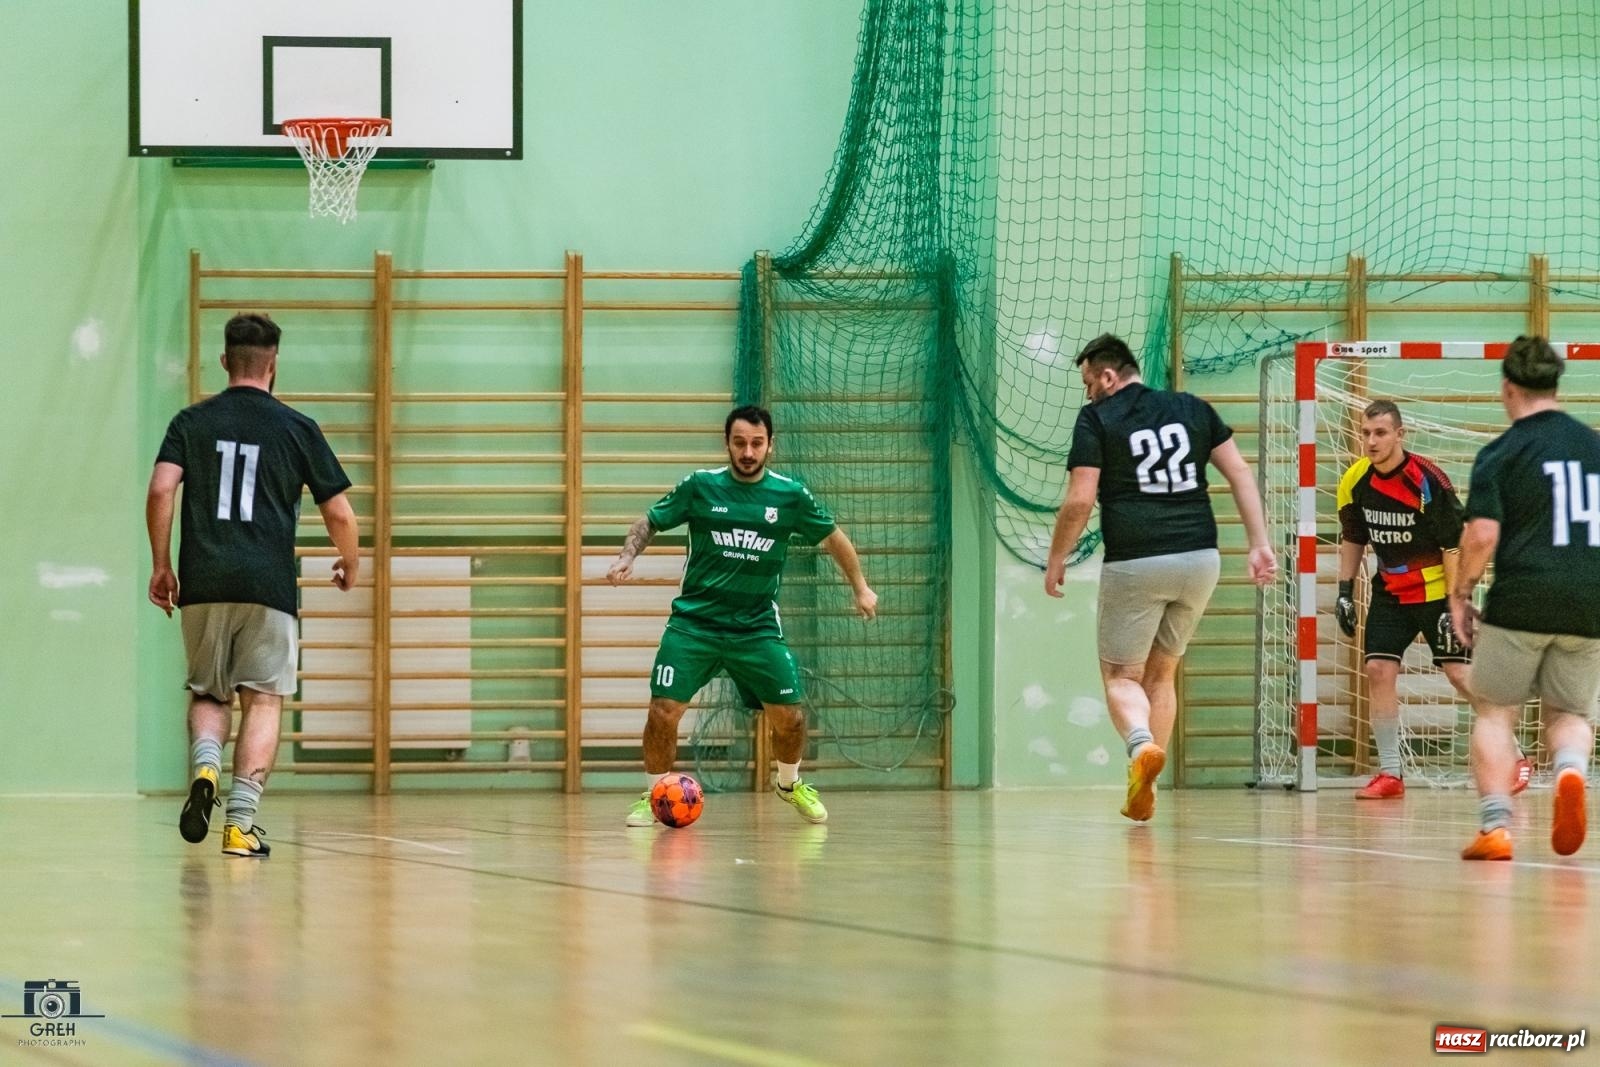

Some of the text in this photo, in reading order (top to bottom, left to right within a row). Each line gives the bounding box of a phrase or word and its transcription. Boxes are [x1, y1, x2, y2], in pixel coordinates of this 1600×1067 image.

[1361, 346, 1387, 354] sport
[1129, 423, 1198, 493] 22
[216, 440, 260, 522] 11
[1542, 461, 1600, 546] 14
[1362, 506, 1416, 526] RUININX
[723, 551, 759, 562] GRUPA PBG
[656, 664, 674, 687] 10
